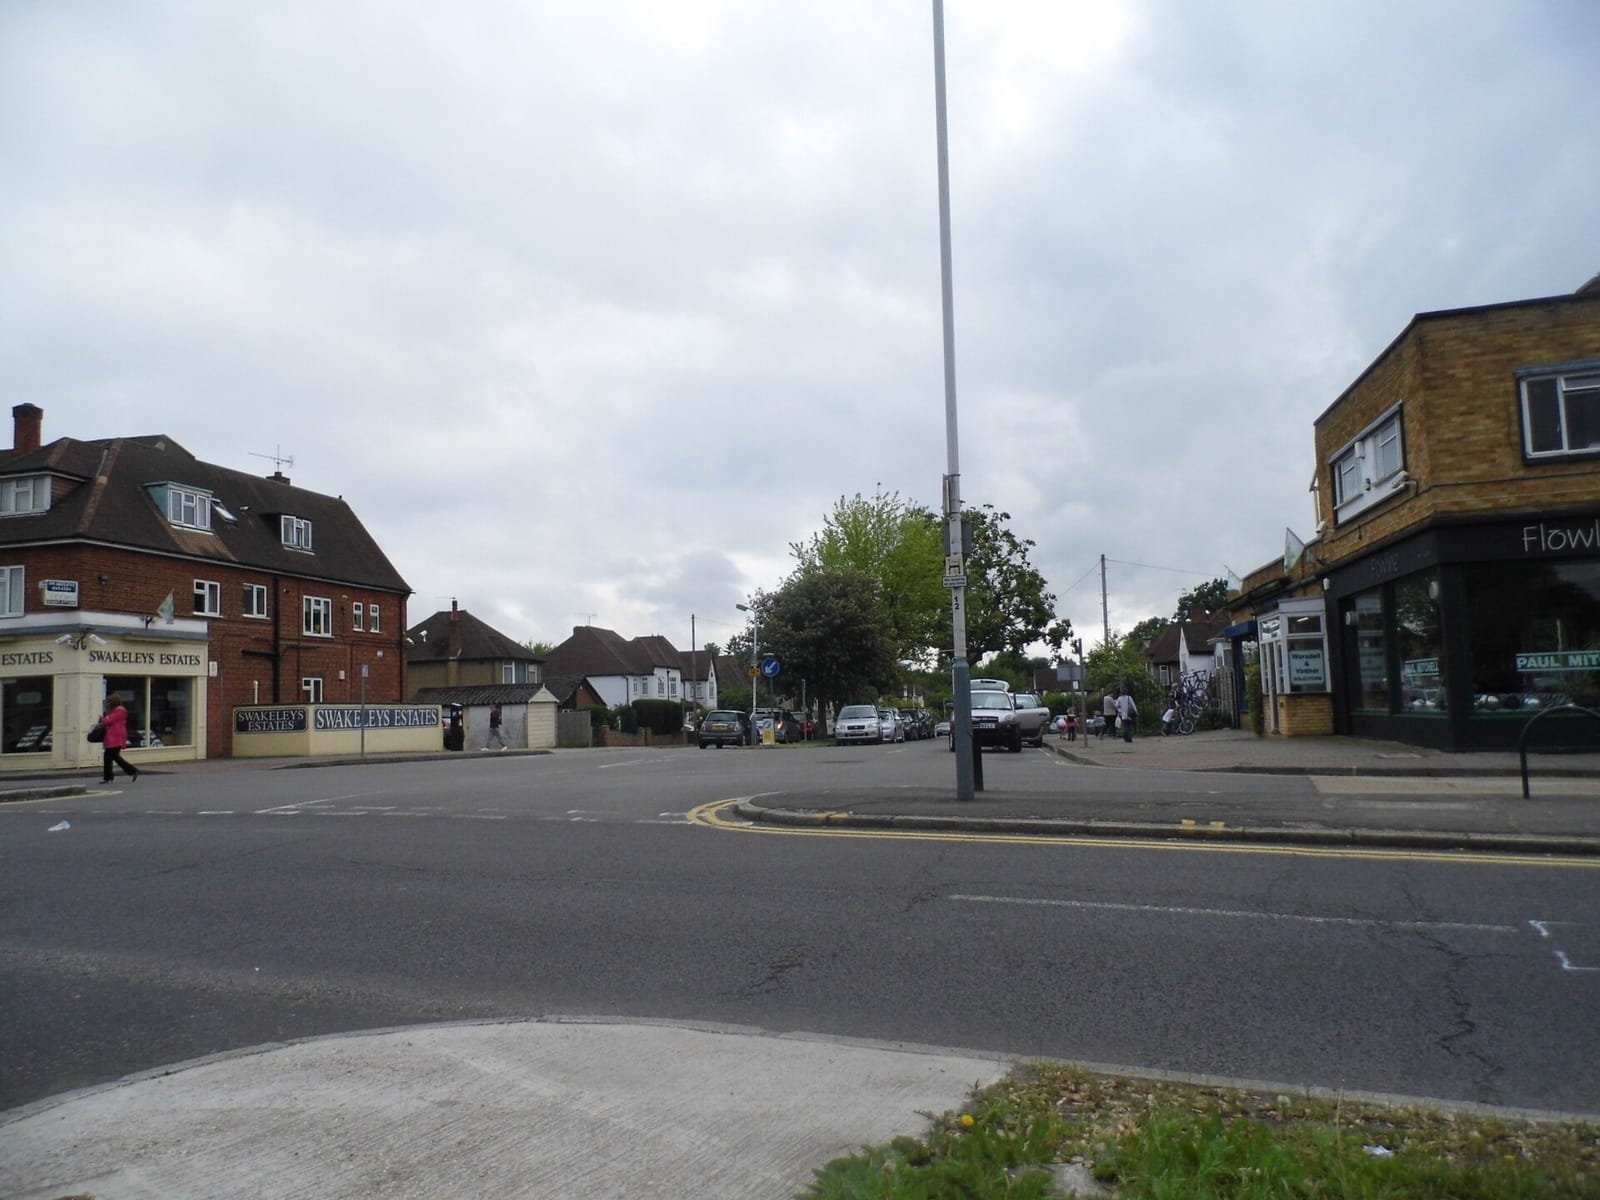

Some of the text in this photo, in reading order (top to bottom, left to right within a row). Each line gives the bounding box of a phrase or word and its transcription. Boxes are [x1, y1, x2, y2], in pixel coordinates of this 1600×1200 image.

[2, 651, 53, 666] ESTATES
[89, 650, 200, 666] SWAKELEYS ESTATES
[1516, 653, 1600, 668] PAUL MIT
[238, 709, 304, 721] SWAKELEYS
[394, 708, 438, 726] ESTATES
[248, 720, 294, 731] ESTATES
